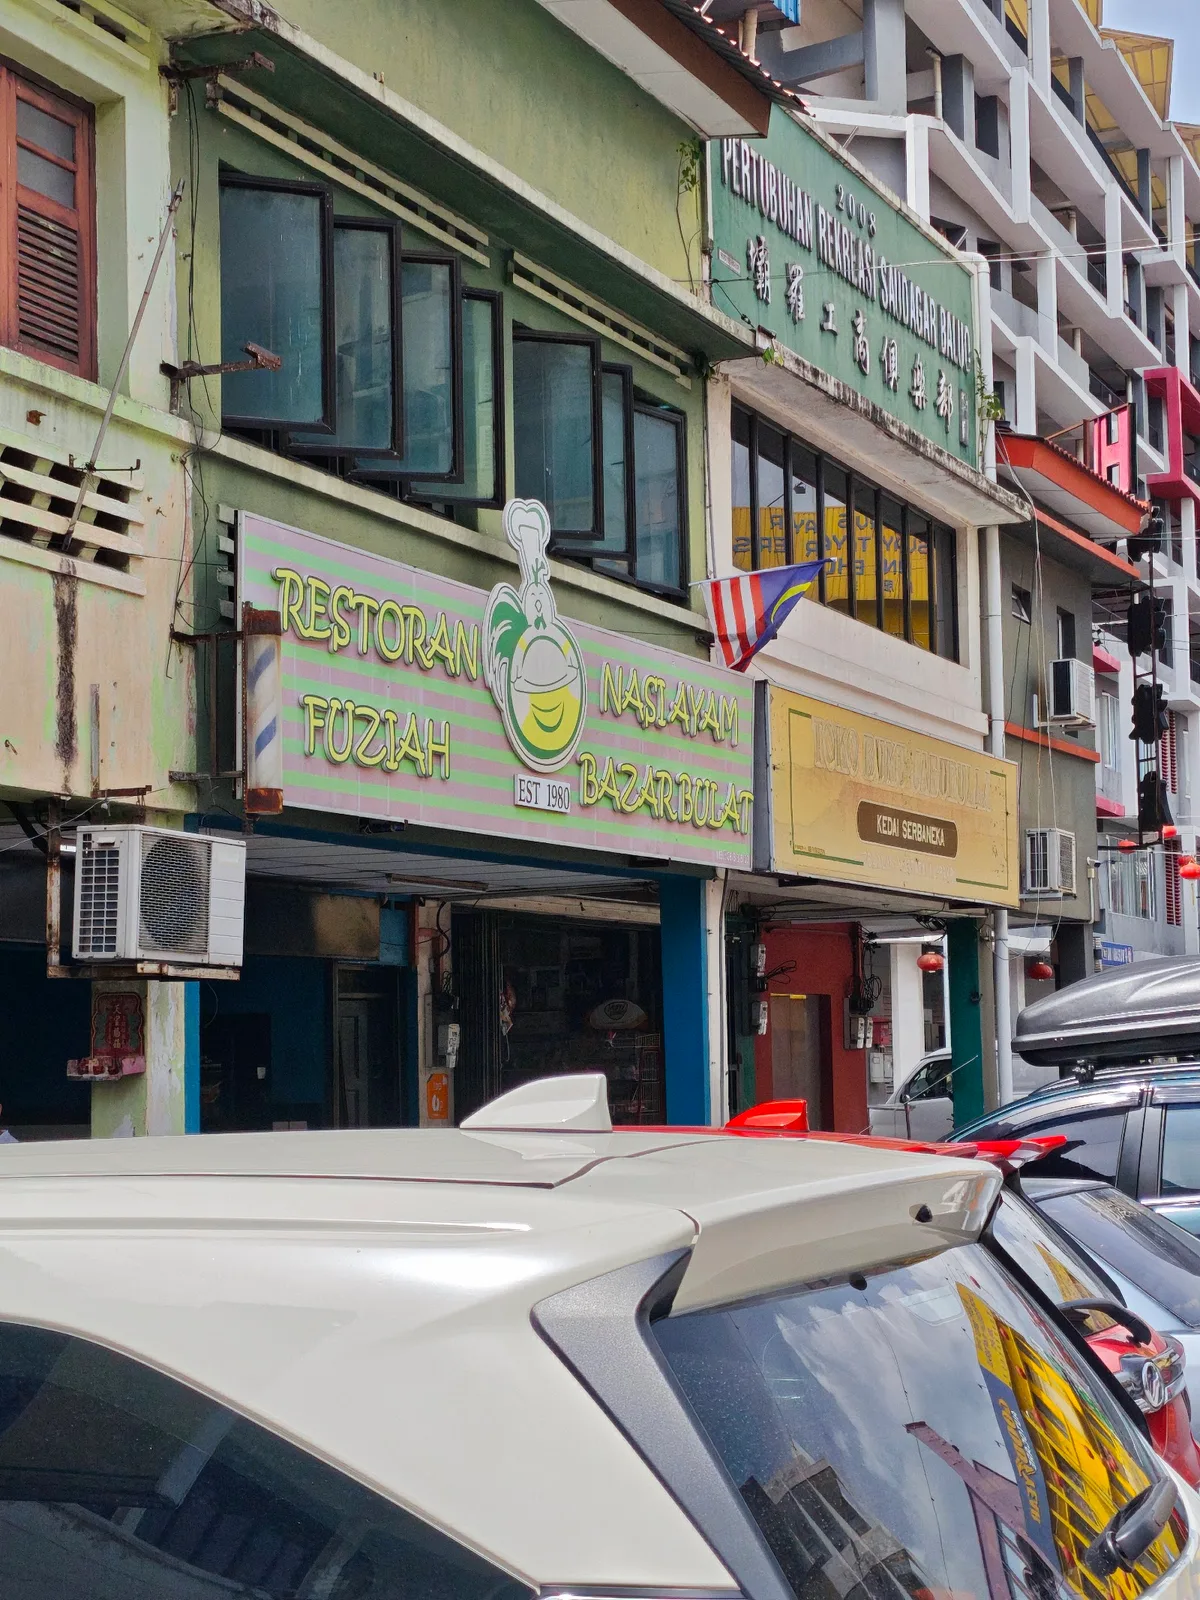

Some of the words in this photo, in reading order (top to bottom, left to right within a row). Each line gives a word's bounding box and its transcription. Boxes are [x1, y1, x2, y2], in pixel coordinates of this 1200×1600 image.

[721, 138, 813, 253] PERTUBUHAN
[816, 203, 876, 301] REKREASI
[878, 256, 937, 349] SAUDAGAR
[836, 183, 876, 238] 2008
[271, 567, 479, 682] RESTORAN
[299, 693, 451, 780] FUZIAH
[599, 661, 668, 729] NASI
[669, 681, 740, 747] AYAM
[518, 778, 540, 808] EST
[547, 784, 570, 811] 1980
[577, 752, 677, 822] BAZAR
[676, 771, 754, 835] BULAT
[876, 814, 900, 838] KEDAI
[902, 819, 945, 847] SERBANEKA
